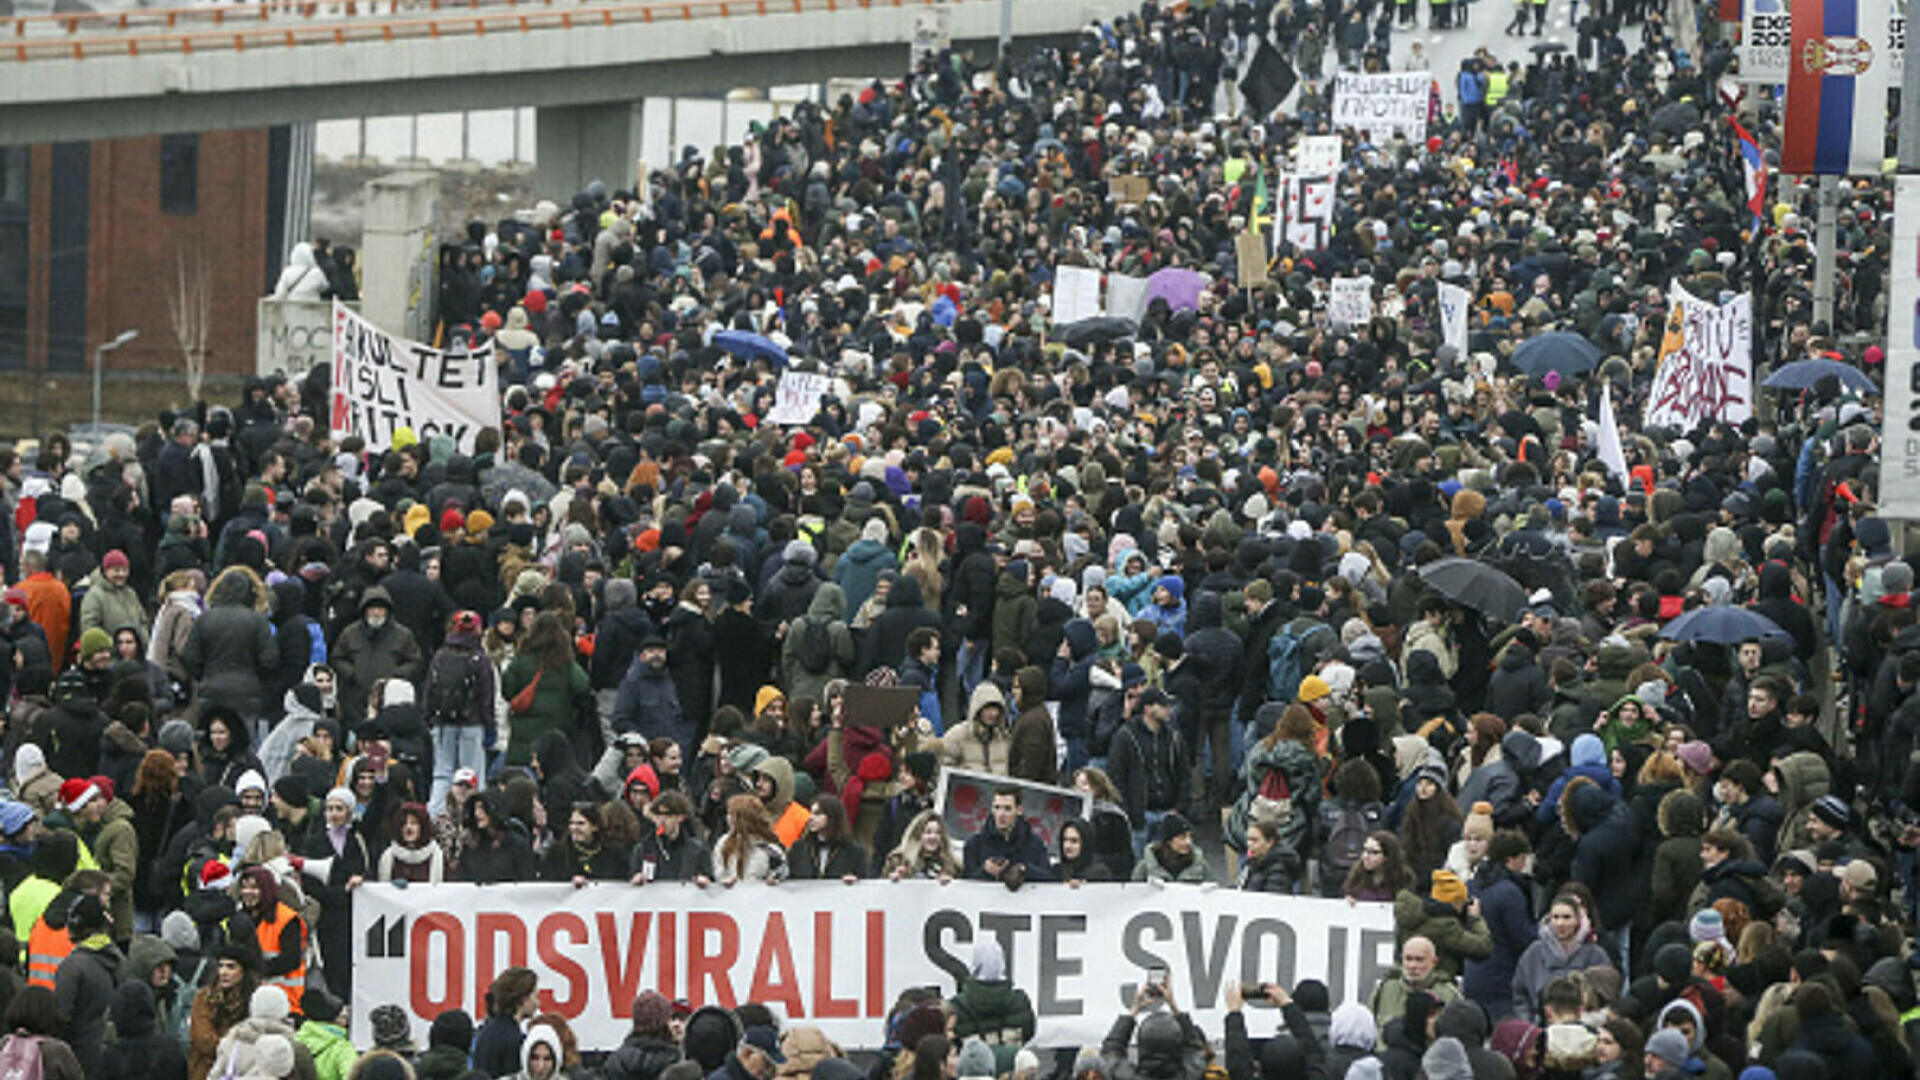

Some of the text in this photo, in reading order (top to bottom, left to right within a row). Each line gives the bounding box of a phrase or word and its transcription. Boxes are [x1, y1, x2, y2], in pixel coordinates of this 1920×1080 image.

[1752, 15, 1791, 30] EXP
[1752, 32, 1791, 46] 202
[923, 909, 1086, 1016] STE
